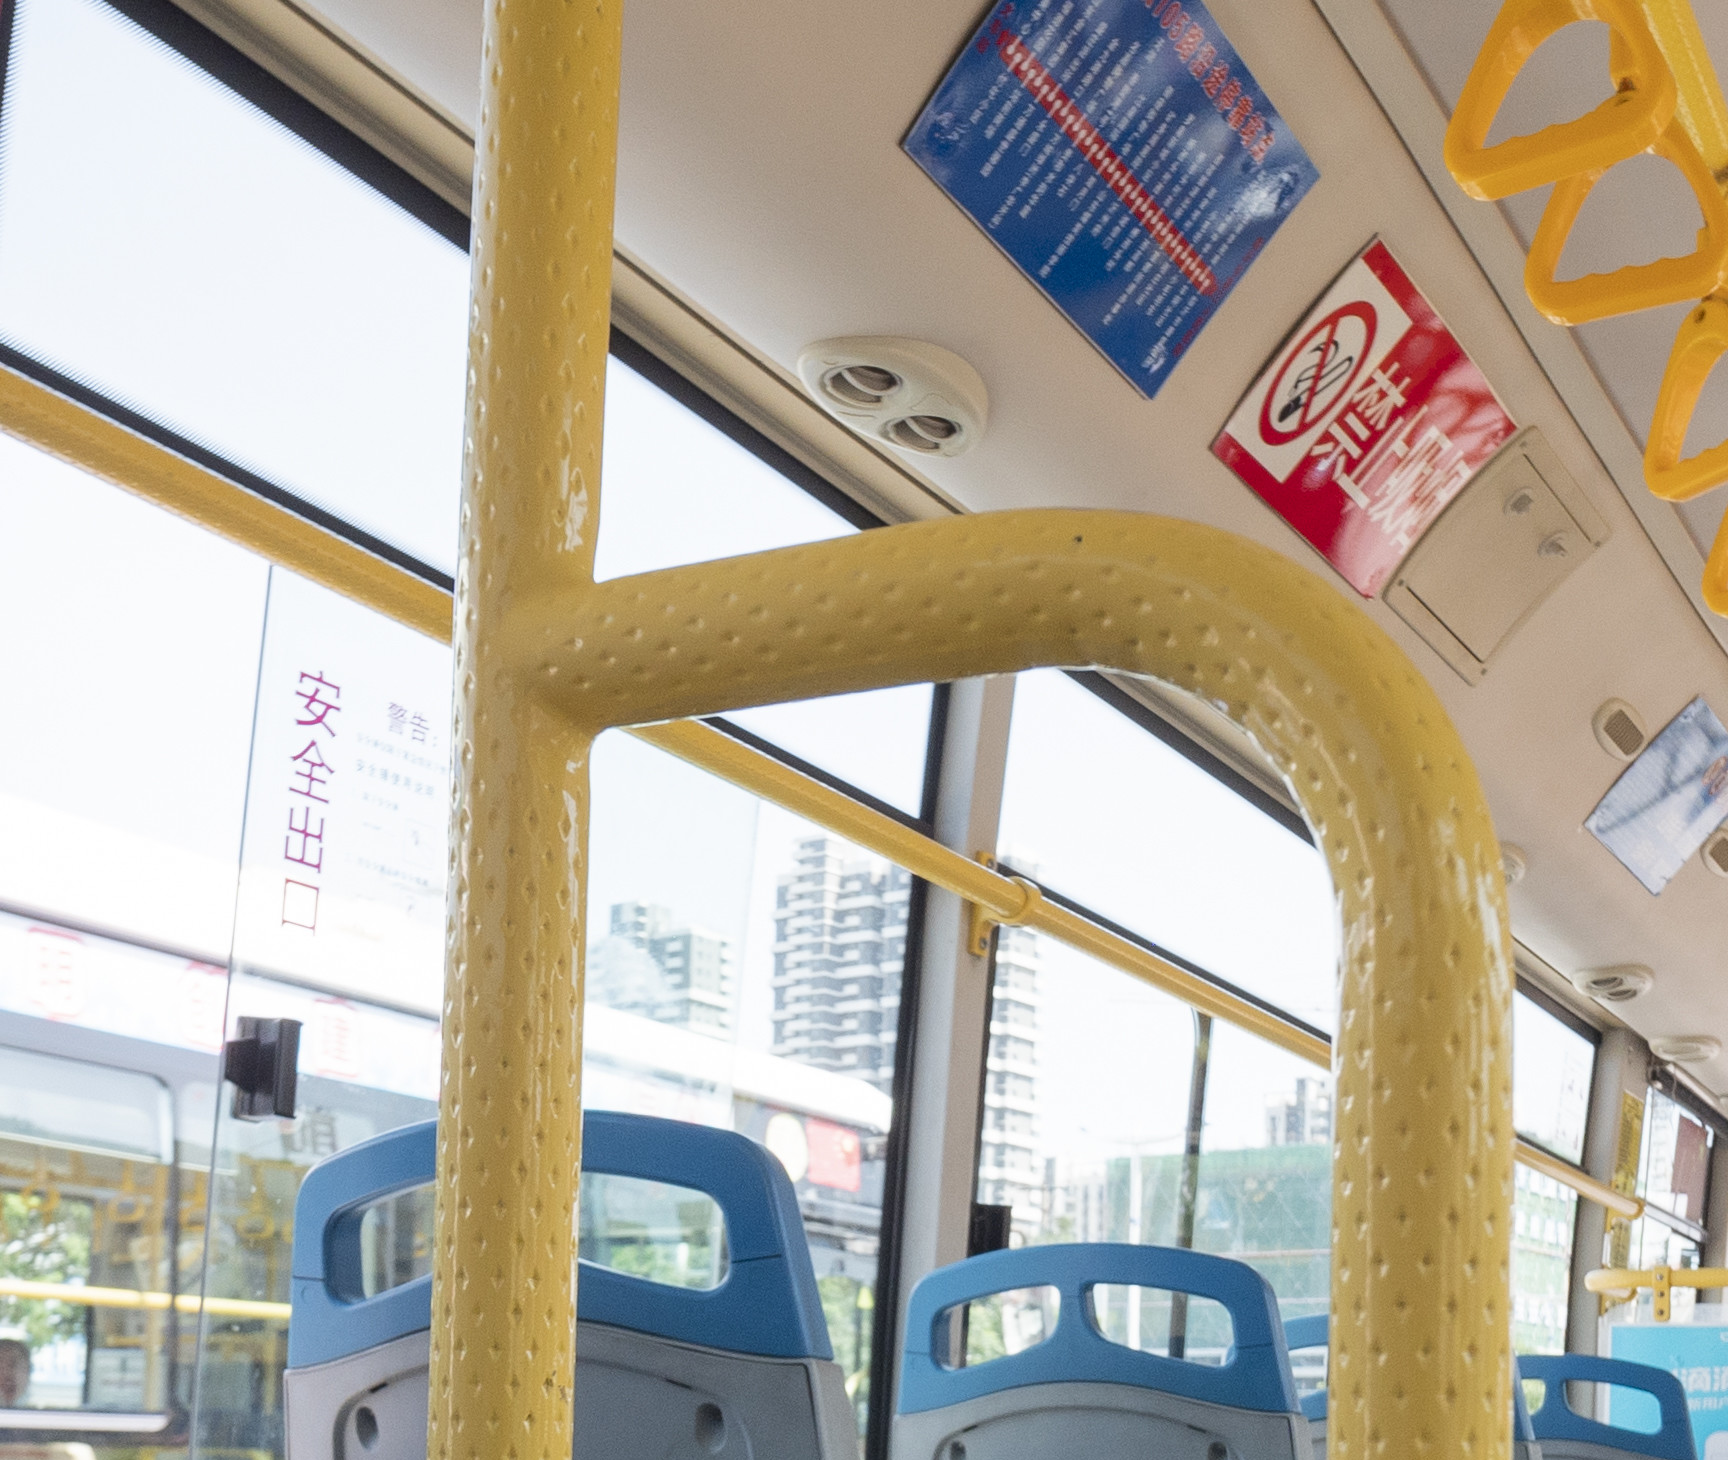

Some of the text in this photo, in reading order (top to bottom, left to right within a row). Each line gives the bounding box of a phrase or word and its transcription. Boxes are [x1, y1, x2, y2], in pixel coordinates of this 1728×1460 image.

[1145, 0, 1275, 165] 105路沿途停靠站点
[1309, 361, 1473, 555] 禁止吸烟
[281, 670, 341, 936] 安全出口
